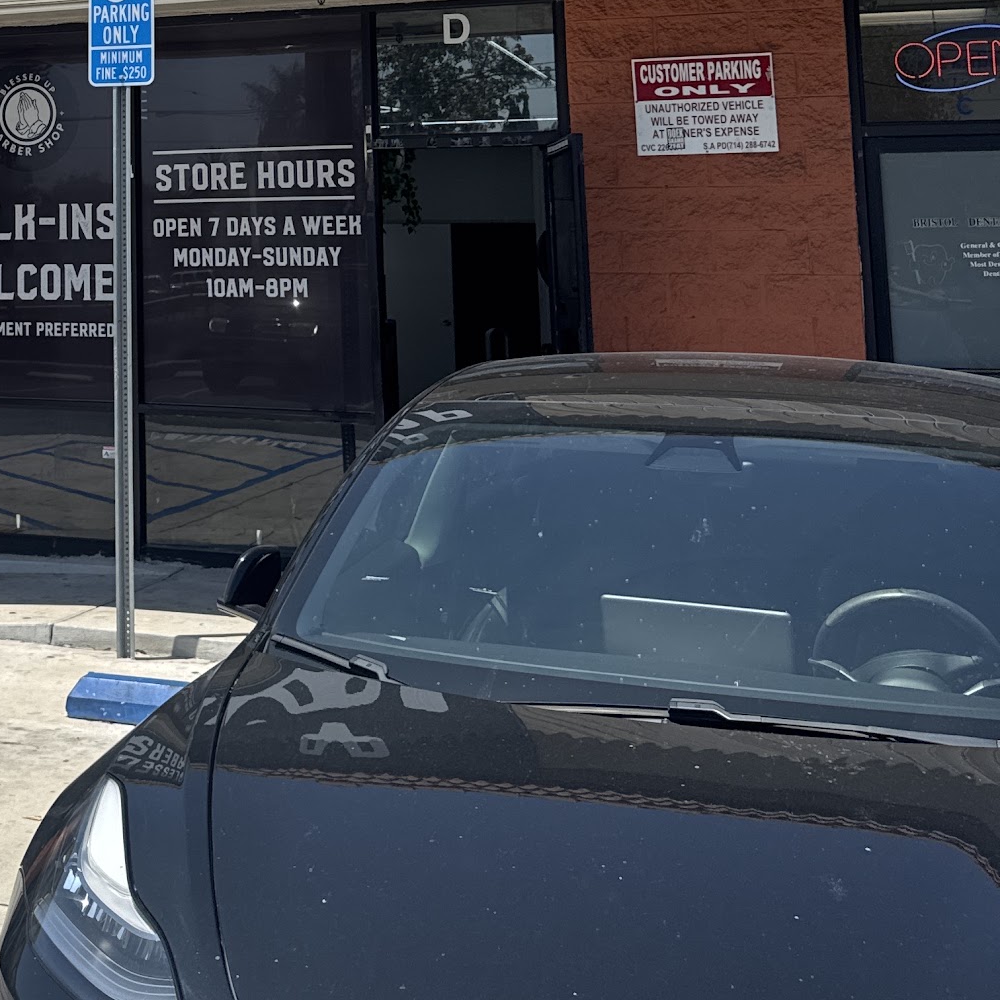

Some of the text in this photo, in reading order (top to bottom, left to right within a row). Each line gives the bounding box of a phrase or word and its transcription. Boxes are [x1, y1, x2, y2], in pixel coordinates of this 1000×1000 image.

[93, 3, 149, 24] PARKING
[103, 25, 139, 44] ONLY
[443, 13, 470, 44] D
[100, 50, 143, 64] MINIMUM
[96, 65, 147, 81] FINE $250
[640, 59, 761, 84] CUSTOMER PARKING
[0, 73, 56, 95] BLESSED UP
[654, 83, 756, 97] ONLY
[645, 100, 764, 114] UNAUTHORIZED VEHICLE
[651, 113, 759, 126] WILL BE TOWED AWAY
[38, 123, 64, 153] SHOP
[652, 129, 665, 139] AT
[714, 126, 760, 137] EXPENSE
[155, 158, 355, 192] STORE HOURS
[153, 215, 362, 238] OPEN 7 DAYS A WEEK
[173, 247, 341, 268] MONDAY-SUNDAY
[206, 277, 308, 298] 10AM-8PM
[36, 322, 114, 338] PREFERRED
